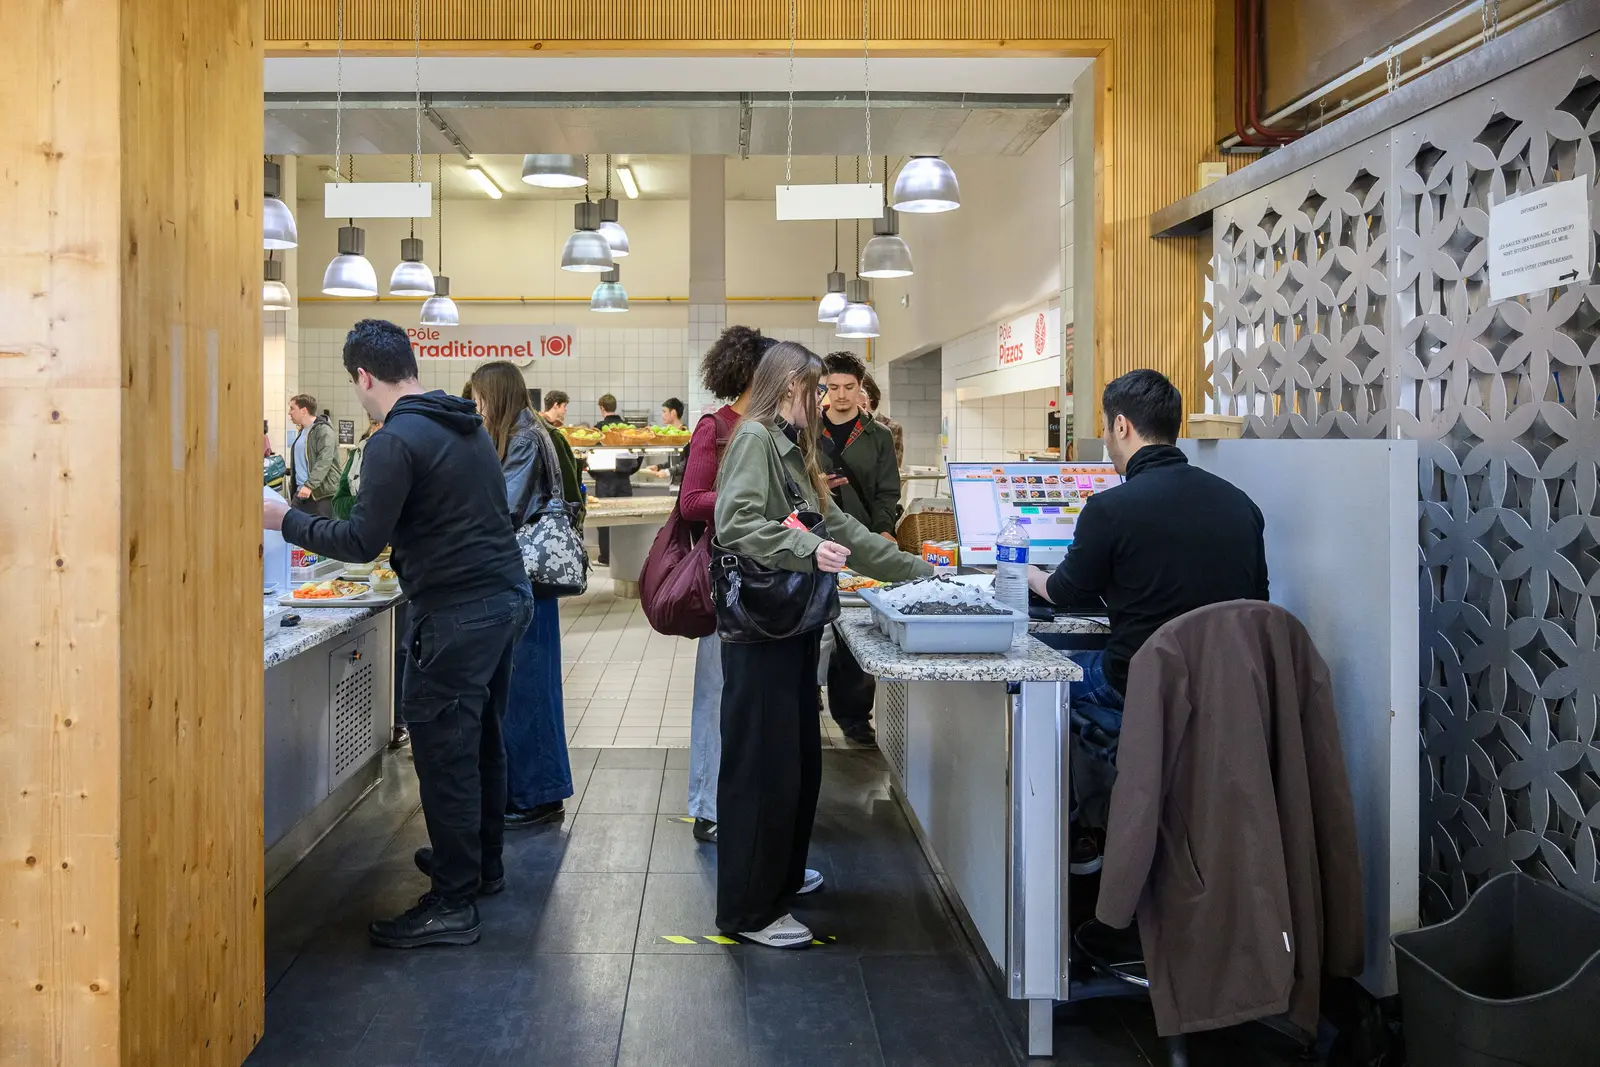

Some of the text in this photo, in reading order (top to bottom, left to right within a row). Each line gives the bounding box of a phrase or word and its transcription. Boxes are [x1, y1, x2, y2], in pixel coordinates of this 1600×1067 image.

[1520, 201, 1548, 215] INFORMATION
[407, 328, 440, 341] Pôle
[999, 322, 1012, 340] Pôle
[999, 341, 1024, 366] Pizzas
